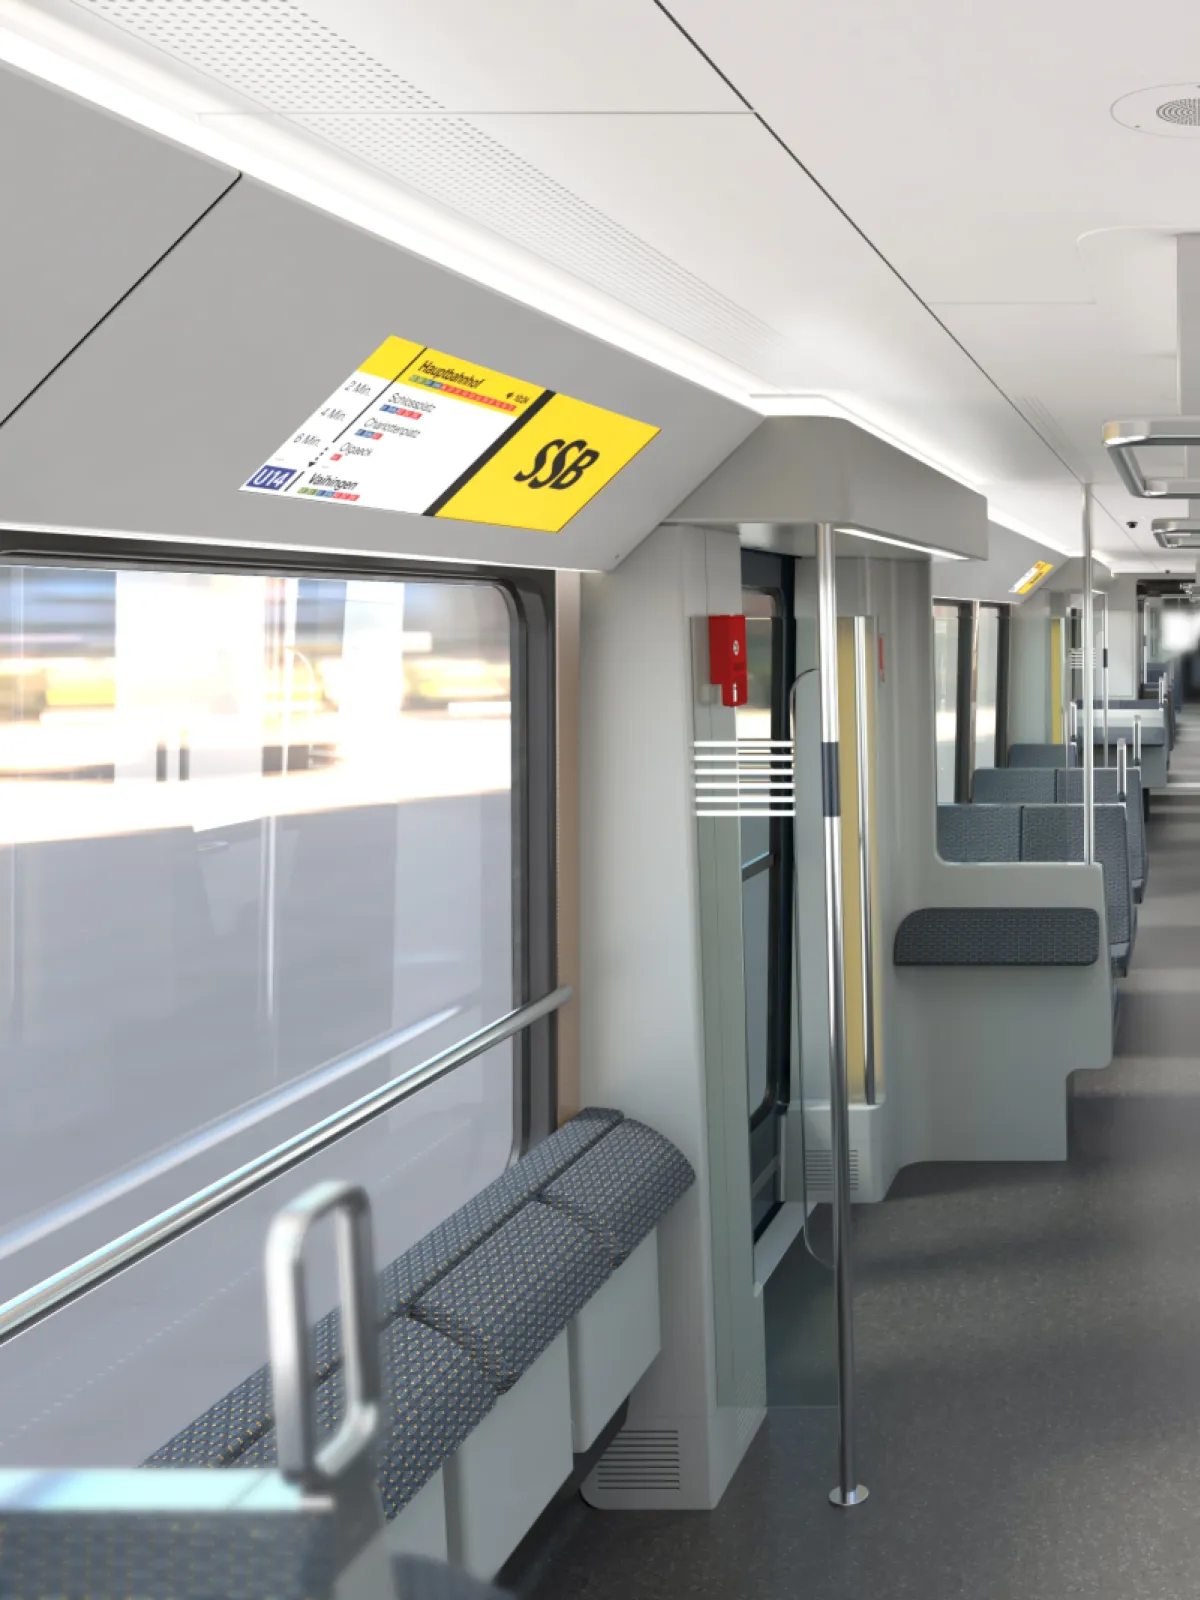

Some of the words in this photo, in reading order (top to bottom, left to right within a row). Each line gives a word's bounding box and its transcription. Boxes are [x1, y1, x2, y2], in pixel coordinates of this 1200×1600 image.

[418, 360, 485, 389] Hauptbahnhof
[344, 381, 355, 392] 2
[356, 382, 371, 397] Min.
[320, 407, 330, 418] 4
[330, 408, 346, 422] Min.
[304, 433, 320, 447] Min.
[513, 438, 600, 490] SSB
[254, 468, 289, 489] U14
[308, 472, 359, 491] Vaihingen
